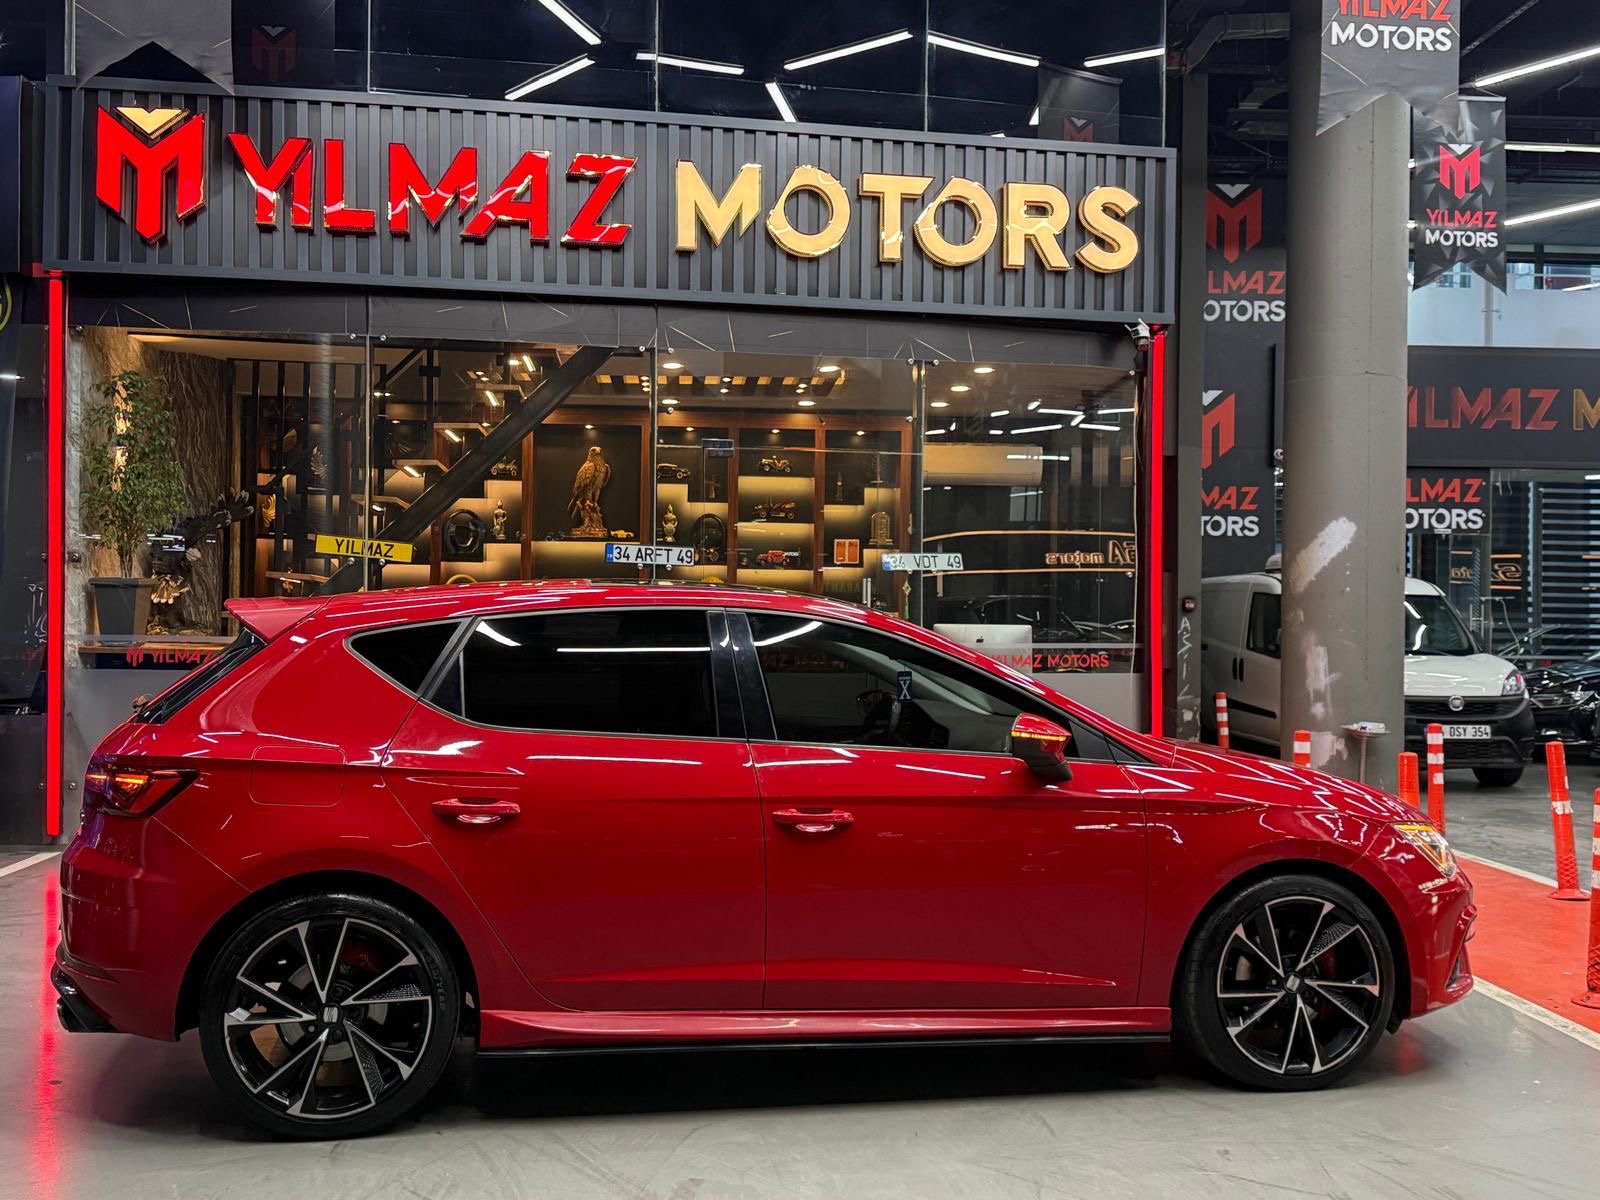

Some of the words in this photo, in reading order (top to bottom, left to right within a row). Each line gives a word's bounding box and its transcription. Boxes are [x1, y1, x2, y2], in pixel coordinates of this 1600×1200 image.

[1331, 21, 1453, 52] MOTORS
[227, 131, 638, 249] YILMAZ
[675, 159, 1140, 274] MOTORS
[1425, 208, 1498, 229] YILMAZ
[1425, 228, 1499, 248] MOTORS
[1207, 270, 1286, 295] LMAZ
[1203, 299, 1286, 322] OTORS
[1201, 486, 1259, 510] MAZ
[1406, 478, 1482, 502] LMAZ
[1201, 515, 1260, 537] TORS
[1405, 508, 1484, 530] OTORS
[335, 538, 395, 559] YILMAZ
[614, 546, 630, 561] 34
[677, 550, 693, 564] 49
[947, 555, 961, 569] 49
[151, 649, 215, 664] YILMAZ
[1047, 653, 1109, 668] MOTORS
[1471, 726, 1489, 738] 354
